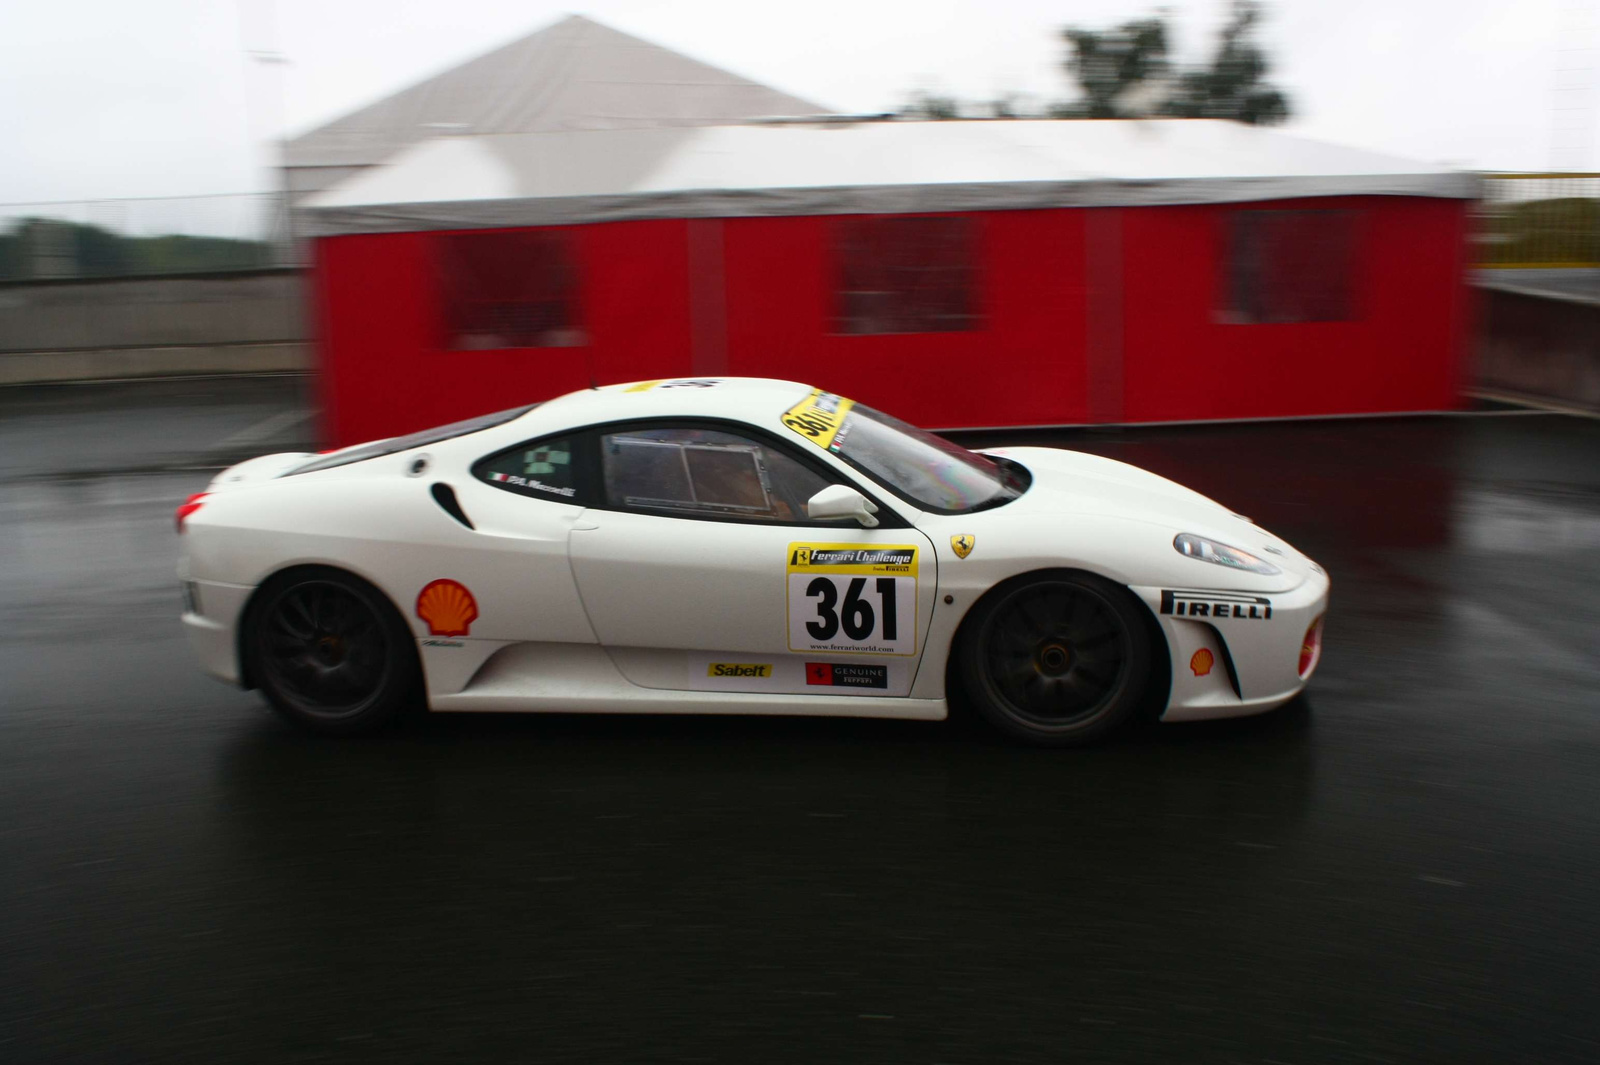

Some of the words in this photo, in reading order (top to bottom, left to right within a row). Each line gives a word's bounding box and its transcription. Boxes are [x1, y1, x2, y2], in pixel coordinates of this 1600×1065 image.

[786, 412, 836, 437] 361
[811, 549, 855, 562] Ferrari
[856, 550, 911, 565] Challenge
[805, 576, 897, 641] 361
[1160, 589, 1272, 620] PIRELLI
[810, 643, 895, 653] www.ferrariworld.com
[714, 664, 766, 677] Sabelt
[834, 667, 884, 677] GENUINE
